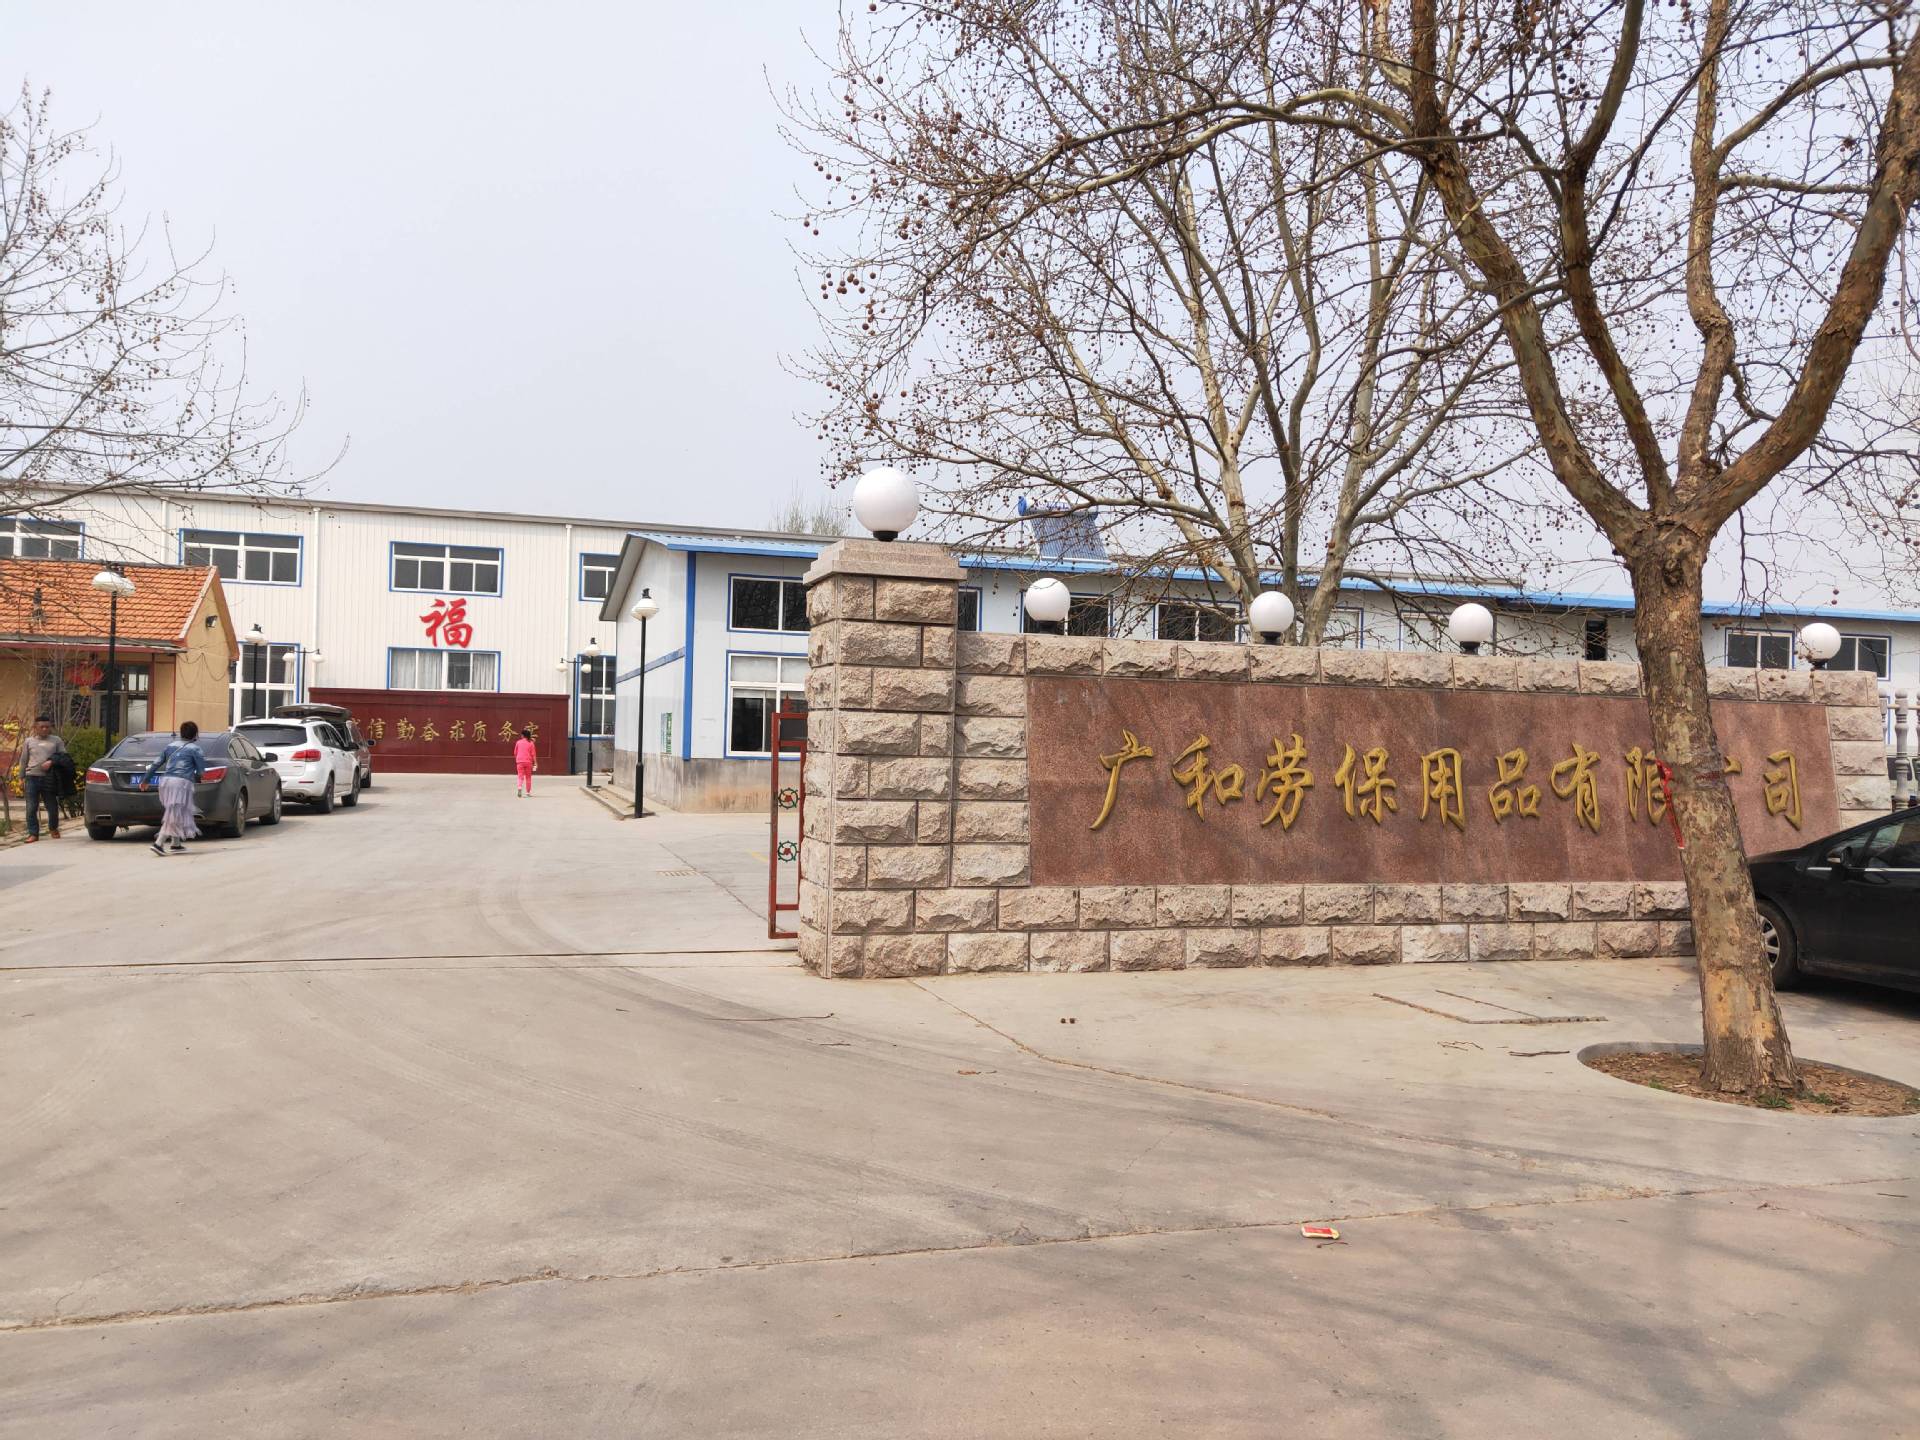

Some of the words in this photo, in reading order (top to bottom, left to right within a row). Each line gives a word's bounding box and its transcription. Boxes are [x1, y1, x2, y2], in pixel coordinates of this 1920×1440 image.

[419, 598, 473, 648] 福
[351, 717, 539, 742] 信勤奋求质务实
[1089, 729, 1801, 832] 广和劳保用品有限司
